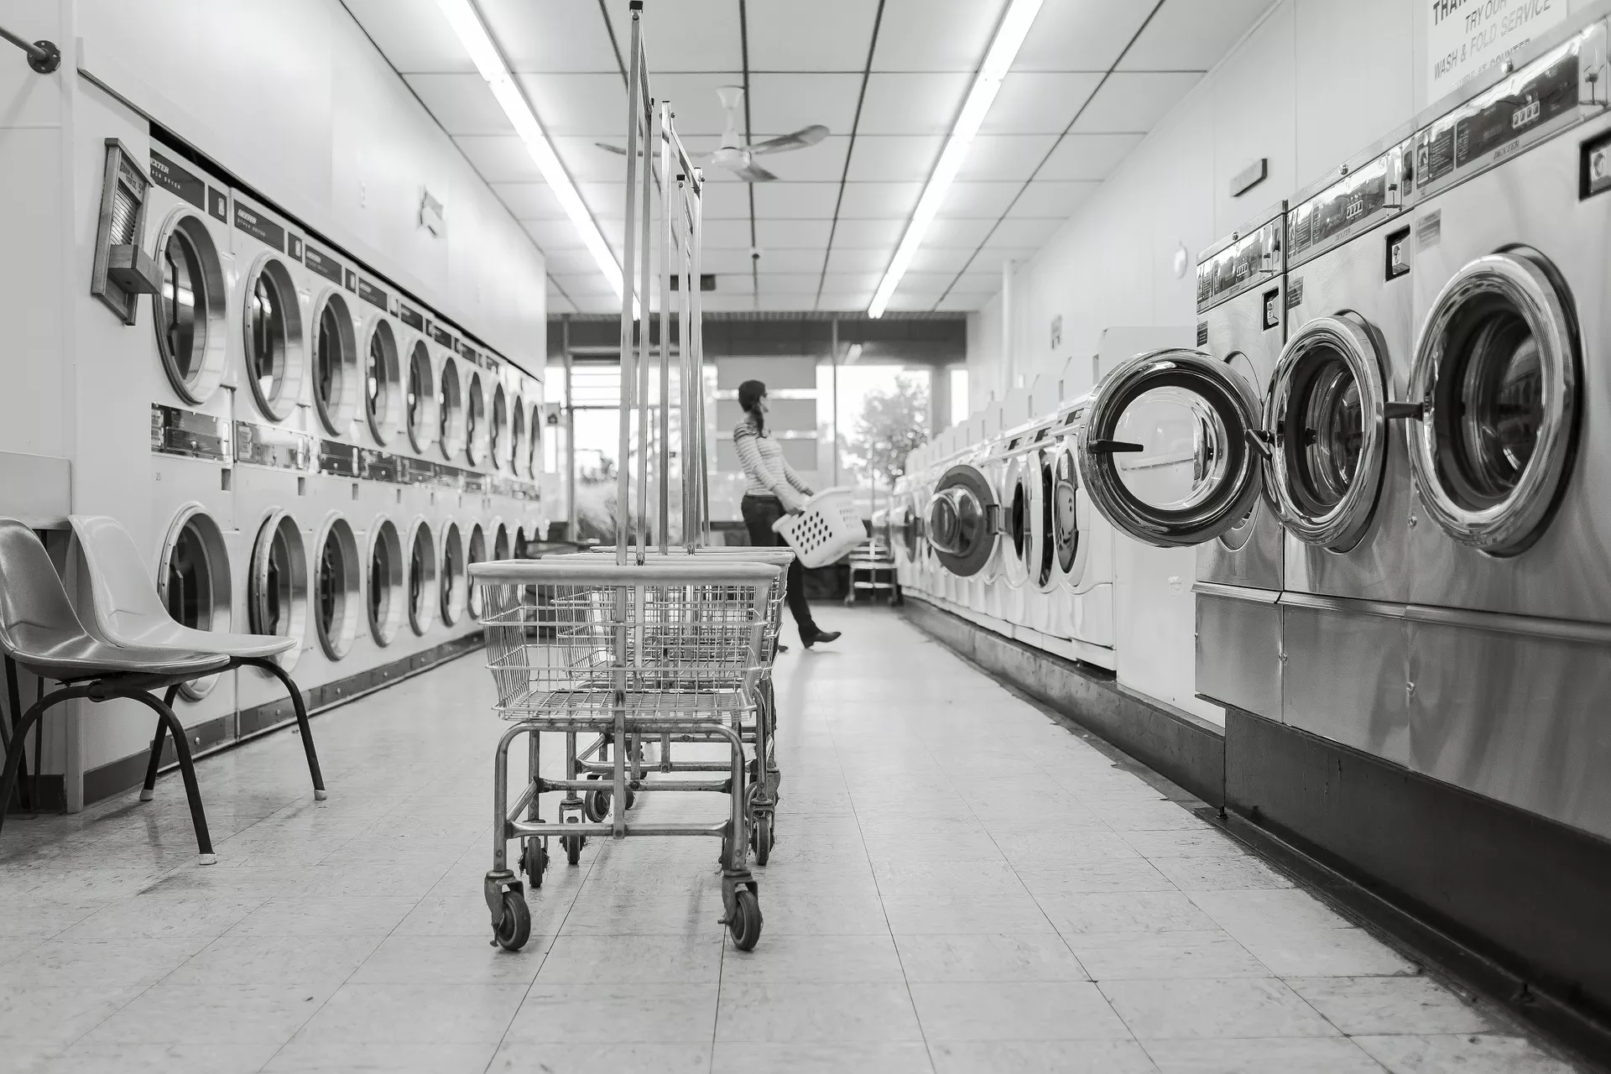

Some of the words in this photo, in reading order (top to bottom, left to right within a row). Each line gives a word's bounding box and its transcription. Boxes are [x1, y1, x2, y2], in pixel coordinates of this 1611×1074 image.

[1465, 6, 1485, 34] TRY
[1434, 48, 1459, 80] WASH
[1460, 43, 1468, 63] &
[1470, 23, 1497, 57] FOLD
[1500, 0, 1551, 37] SERVICE
[150, 157, 170, 175] EXTER
